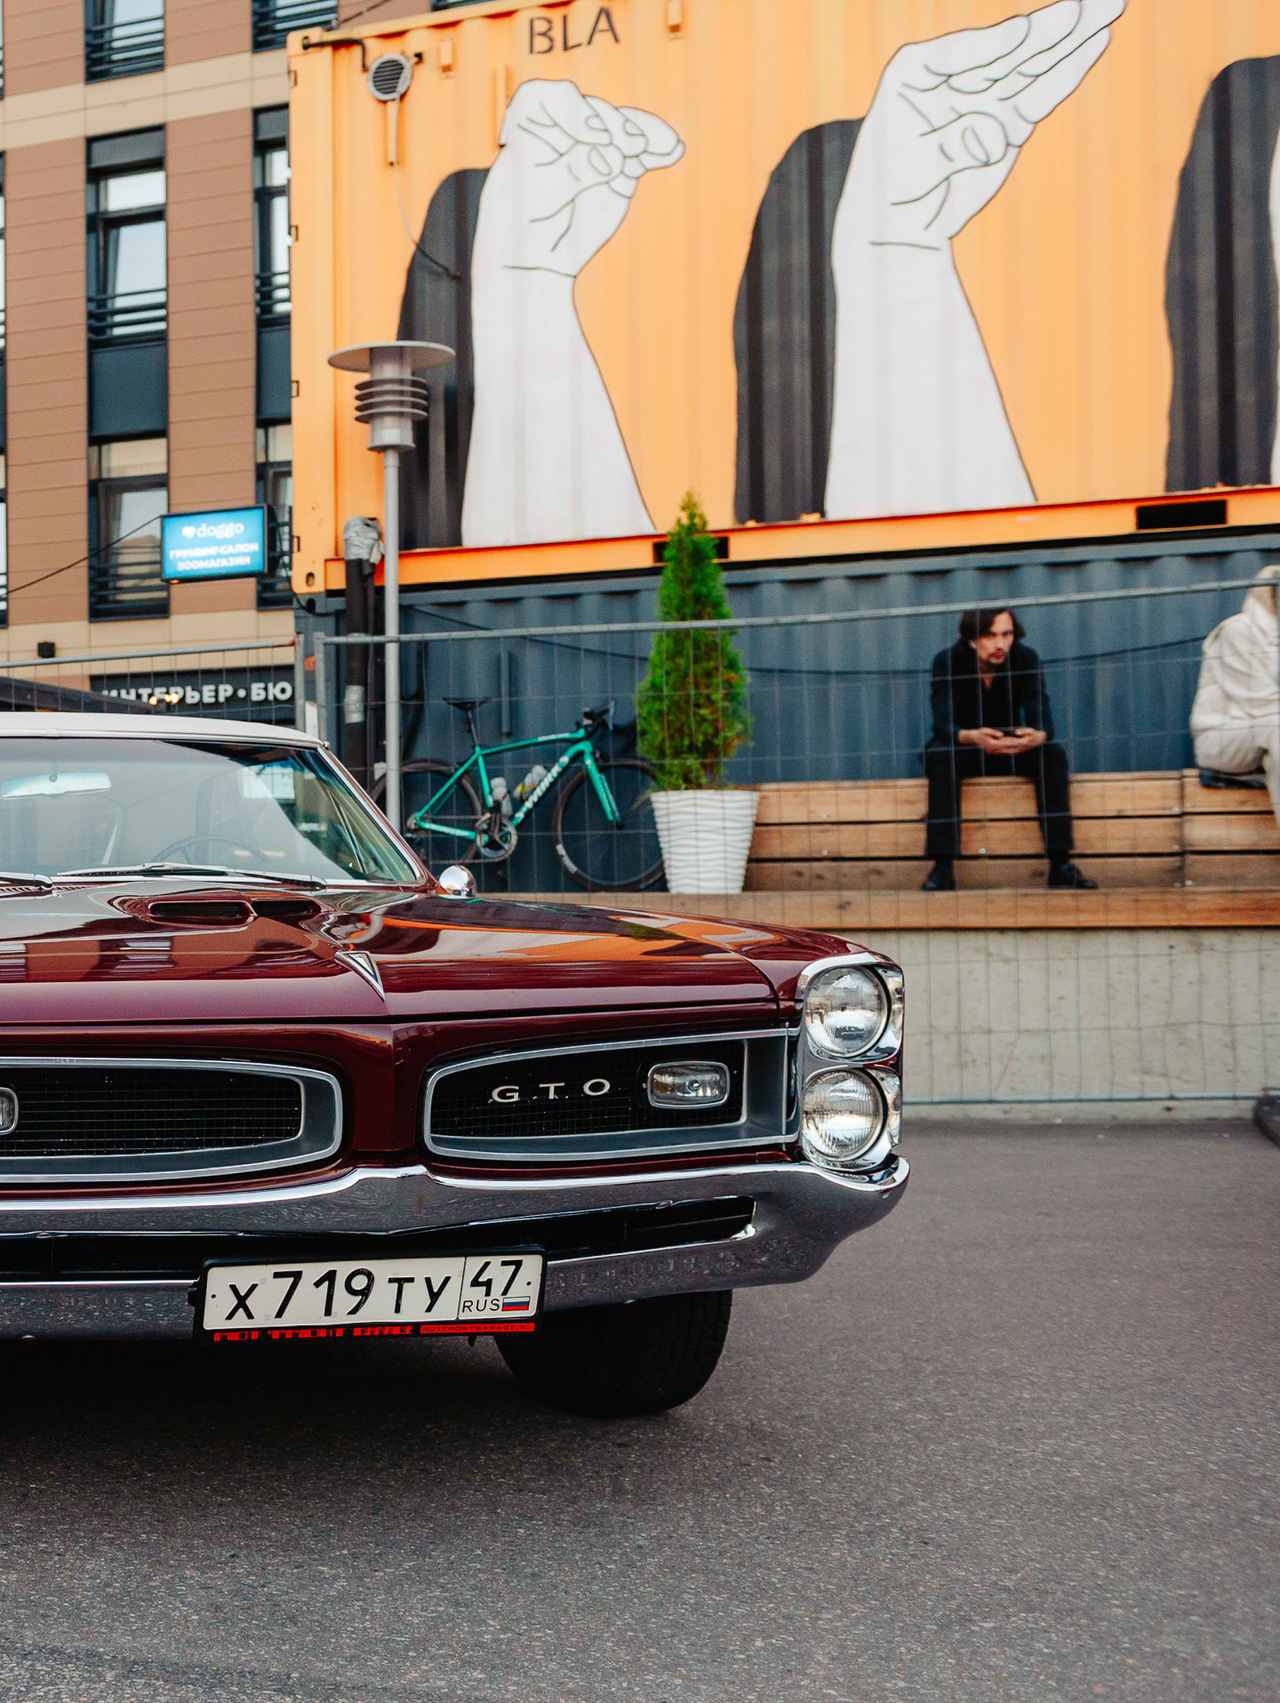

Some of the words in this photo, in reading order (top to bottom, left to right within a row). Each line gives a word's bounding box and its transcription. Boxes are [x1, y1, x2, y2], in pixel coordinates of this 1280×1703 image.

[529, 7, 620, 54] BLA
[196, 522, 245, 539] doggo
[177, 556, 251, 571] ЗООМАГАЗИН
[491, 1078, 610, 1103] GTO
[470, 1259, 523, 1297] 47
[462, 1299, 500, 1314] RUS
